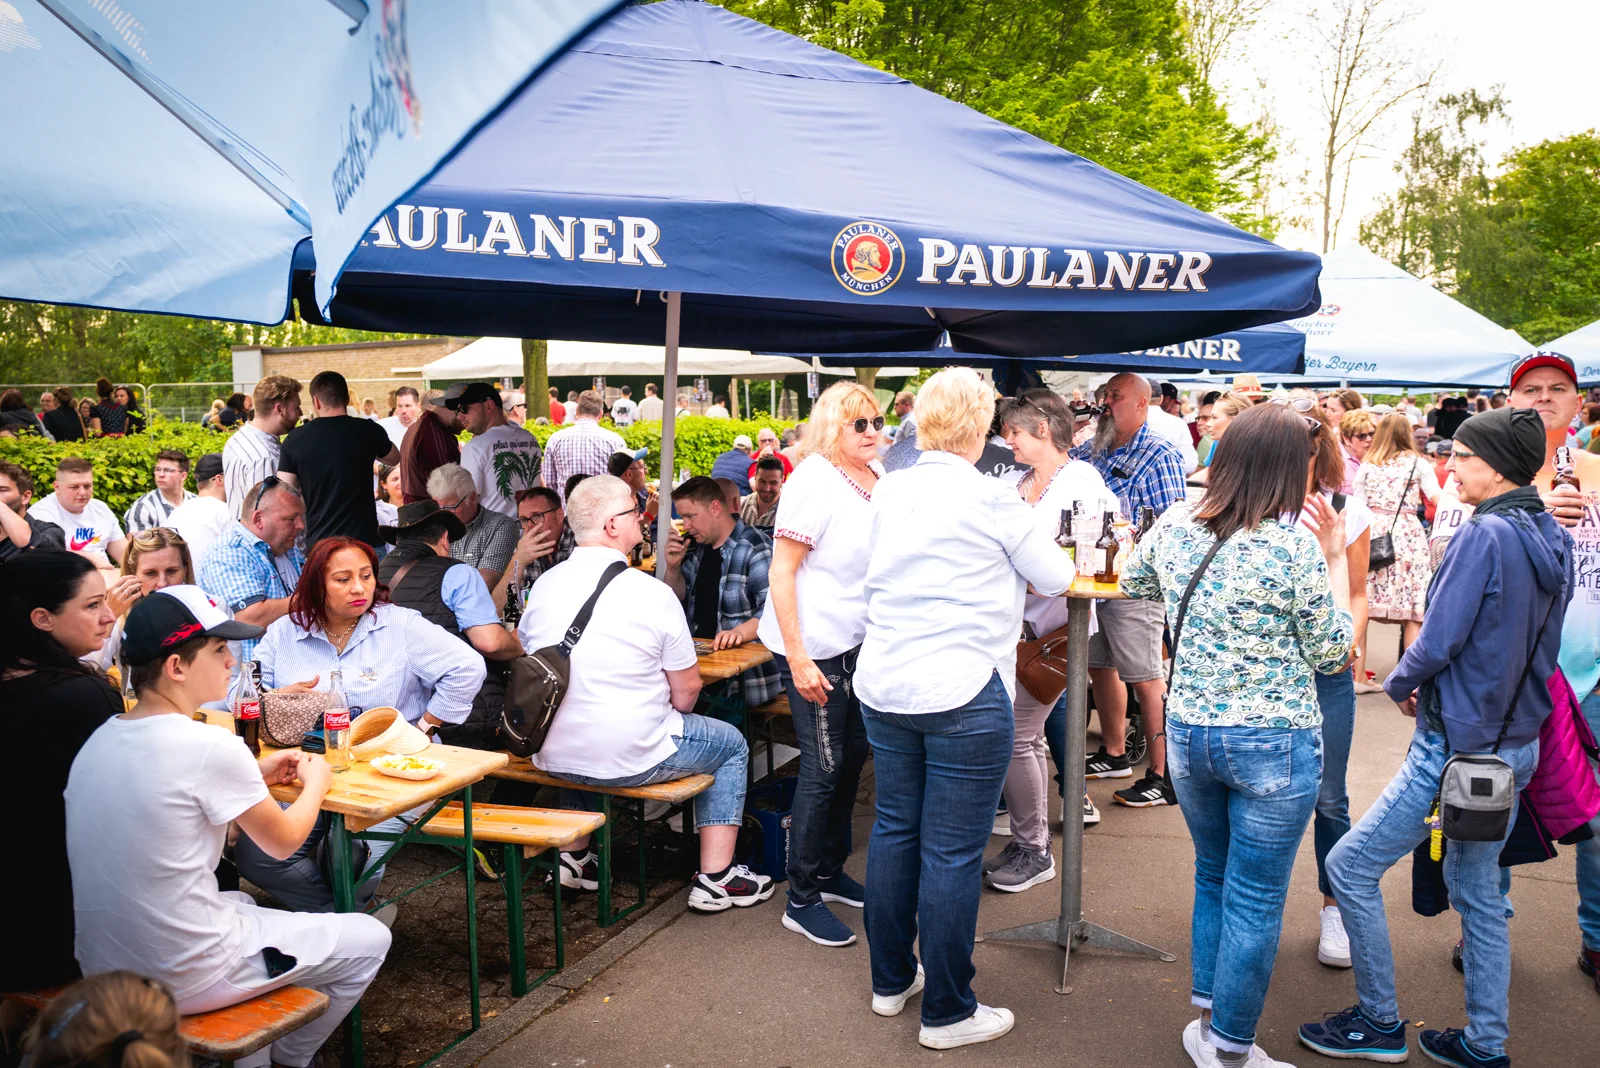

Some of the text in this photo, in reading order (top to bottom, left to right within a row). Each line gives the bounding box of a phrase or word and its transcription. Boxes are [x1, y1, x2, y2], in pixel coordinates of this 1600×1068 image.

[359, 204, 667, 267] AULANER
[836, 225, 899, 251] PAULANER
[916, 237, 1213, 292] PAULANER
[841, 272, 893, 292] MÜNCHEN
[1304, 328, 1334, 336] horr
[1325, 356, 1377, 373] Bayern
